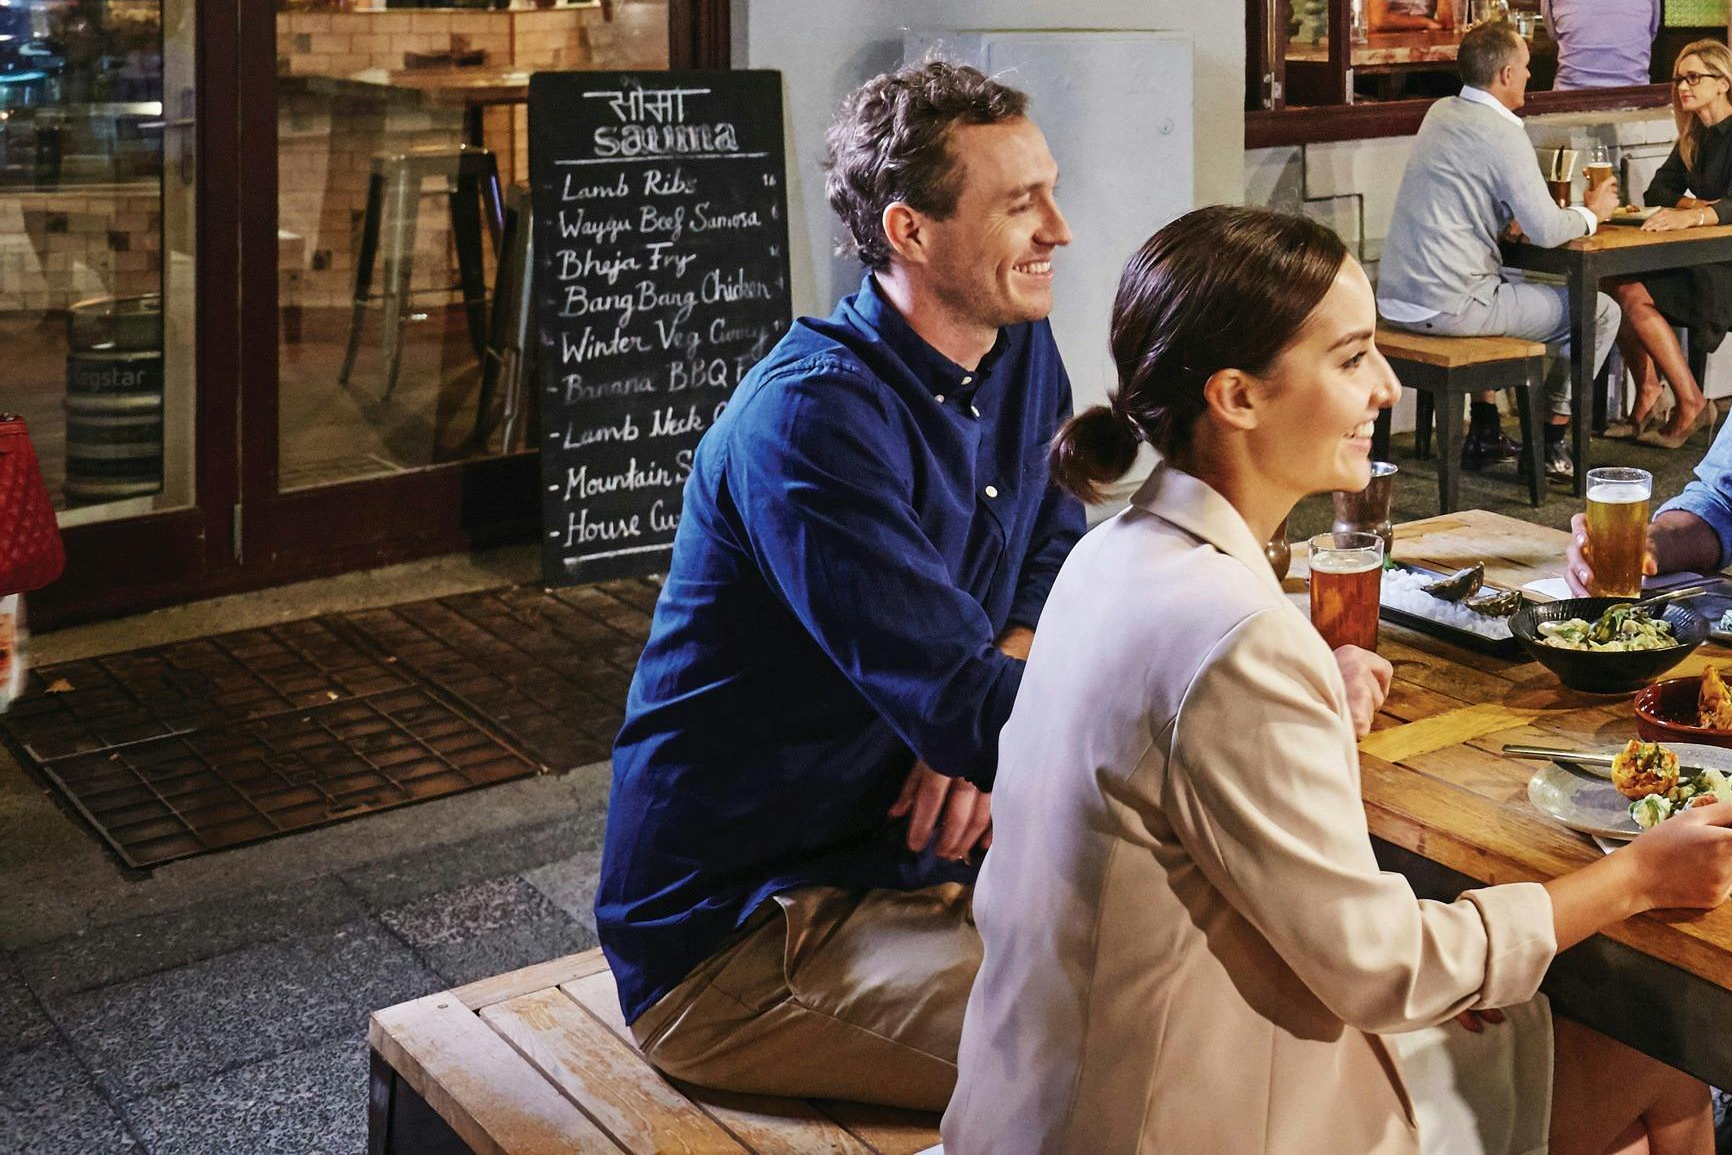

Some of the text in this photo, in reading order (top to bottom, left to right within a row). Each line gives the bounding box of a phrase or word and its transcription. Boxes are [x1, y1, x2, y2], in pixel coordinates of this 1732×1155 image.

[562, 172, 629, 201] Lamb
[644, 167, 697, 196] Ribs
[640, 205, 685, 242] Beef
[689, 201, 762, 232] Samosa
[556, 242, 697, 285] Bheja Fry
[558, 285, 635, 327] Bang
[635, 280, 698, 324] Bang
[561, 326, 652, 363] Winter
[654, 319, 700, 359] Veg
[668, 359, 728, 392] BBQ
[563, 414, 639, 449] Lamb
[650, 405, 704, 437] Neck
[564, 457, 672, 501] Mountain
[564, 508, 641, 547] House
